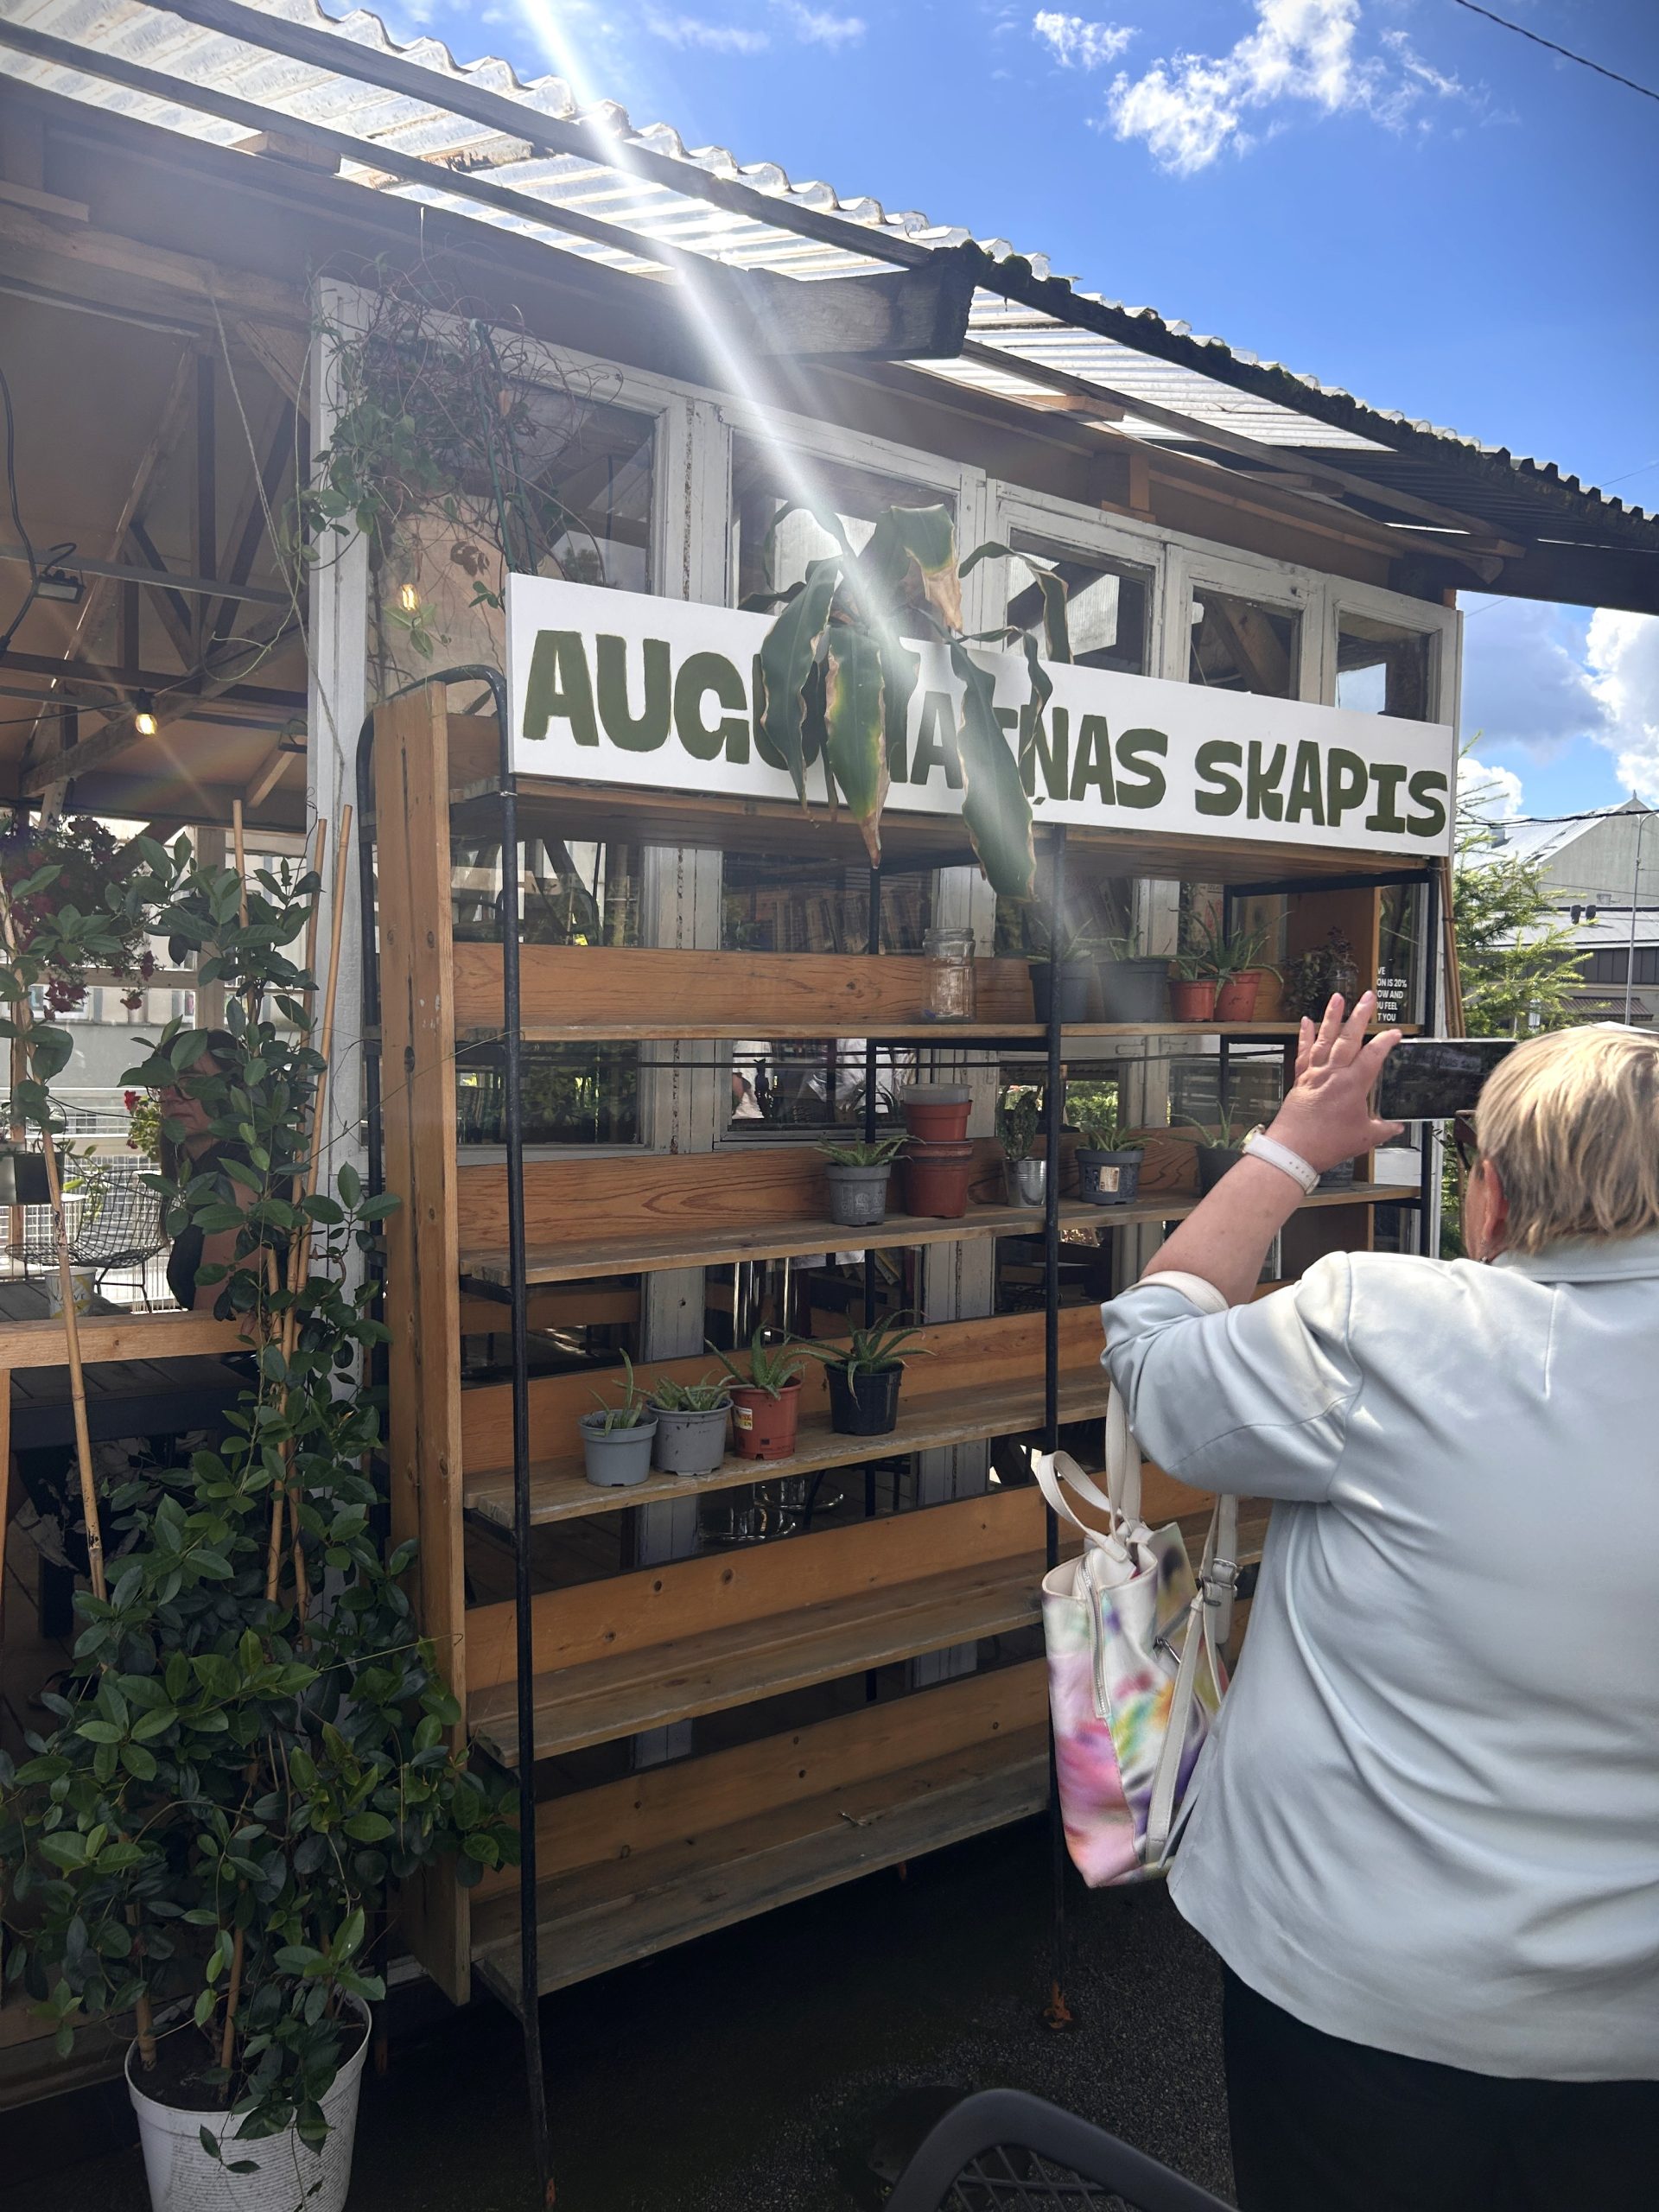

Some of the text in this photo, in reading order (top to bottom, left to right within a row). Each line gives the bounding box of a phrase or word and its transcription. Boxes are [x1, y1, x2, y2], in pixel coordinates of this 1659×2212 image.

[881, 690, 1168, 810] AŅAS
[1195, 739, 1448, 838] SKAPIS
[1387, 978, 1394, 987] IS
[1394, 979, 1407, 988] 20%
[1389, 990, 1404, 999] AND
[1382, 1013, 1396, 1021] YOU
